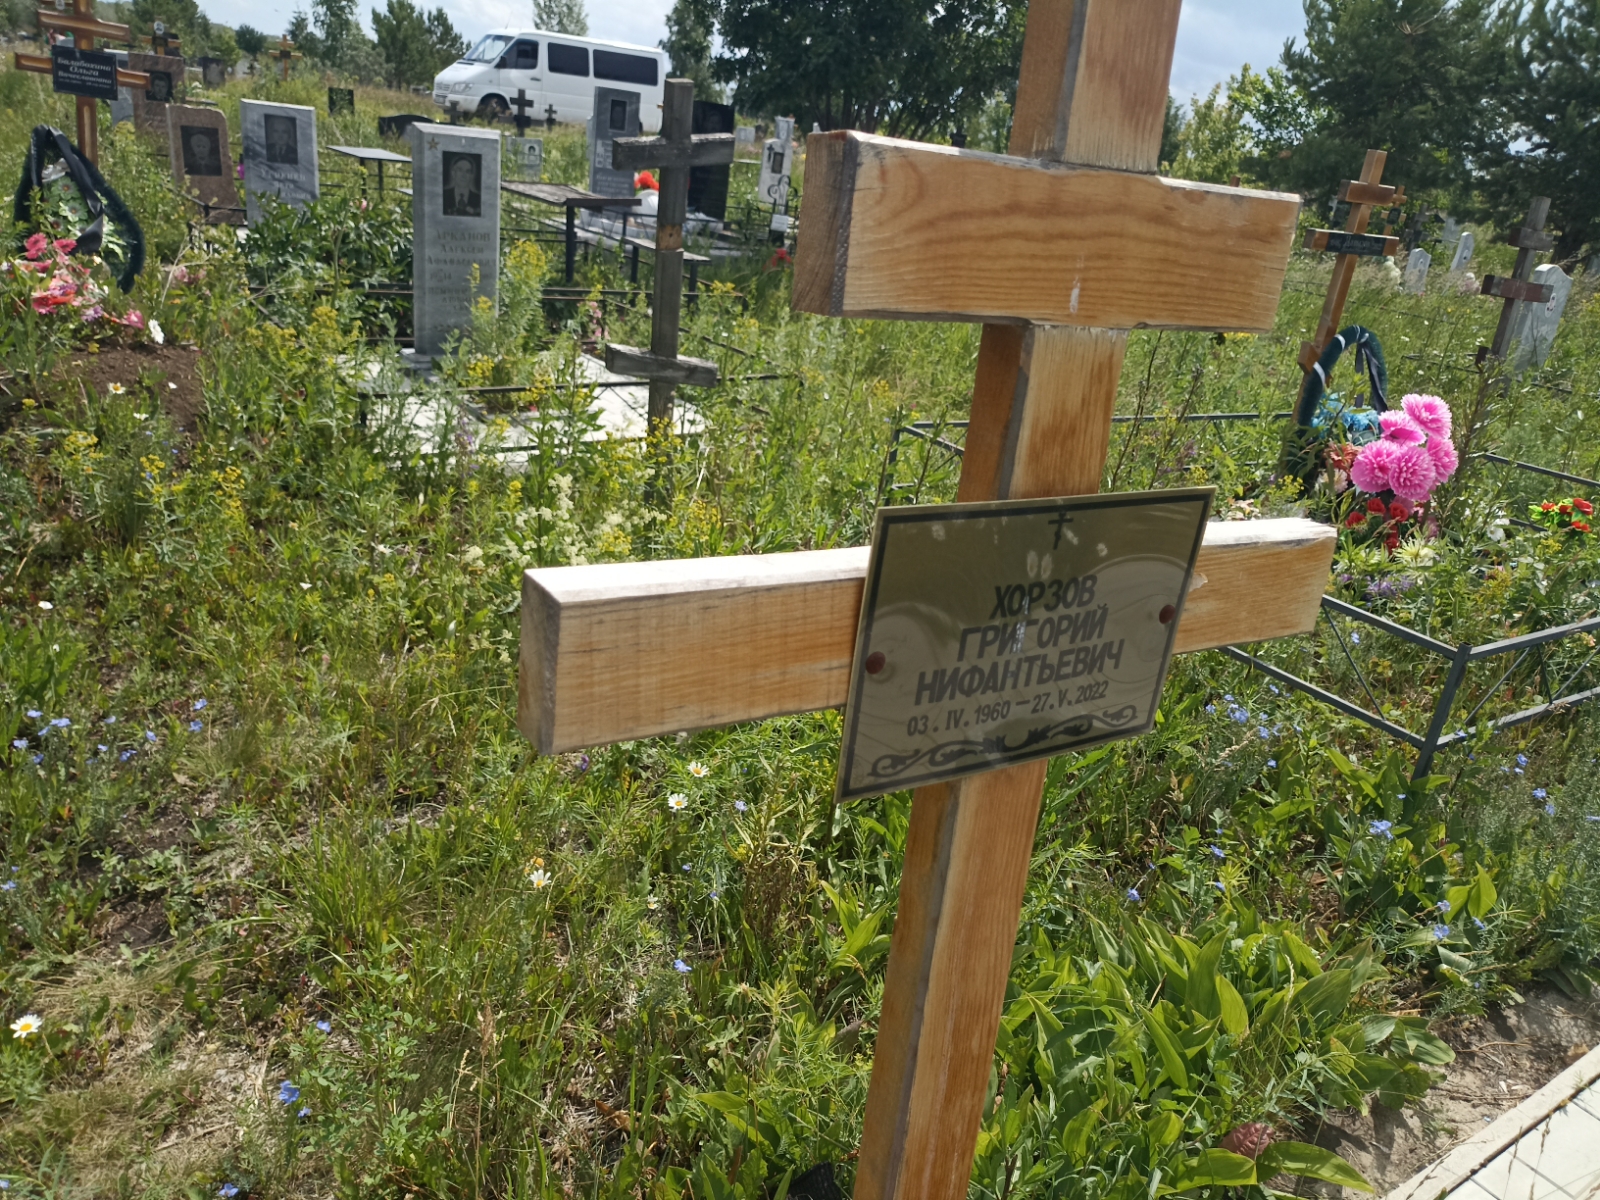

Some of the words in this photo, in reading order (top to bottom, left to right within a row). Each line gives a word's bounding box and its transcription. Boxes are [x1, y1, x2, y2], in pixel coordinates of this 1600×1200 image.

[69, 65, 99, 76] Ольга
[989, 574, 1098, 620] ХОРЗОВ
[956, 603, 1109, 662] ГРИГОРИЙ
[914, 638, 1126, 706] НИФАНТЬЕВИЧ
